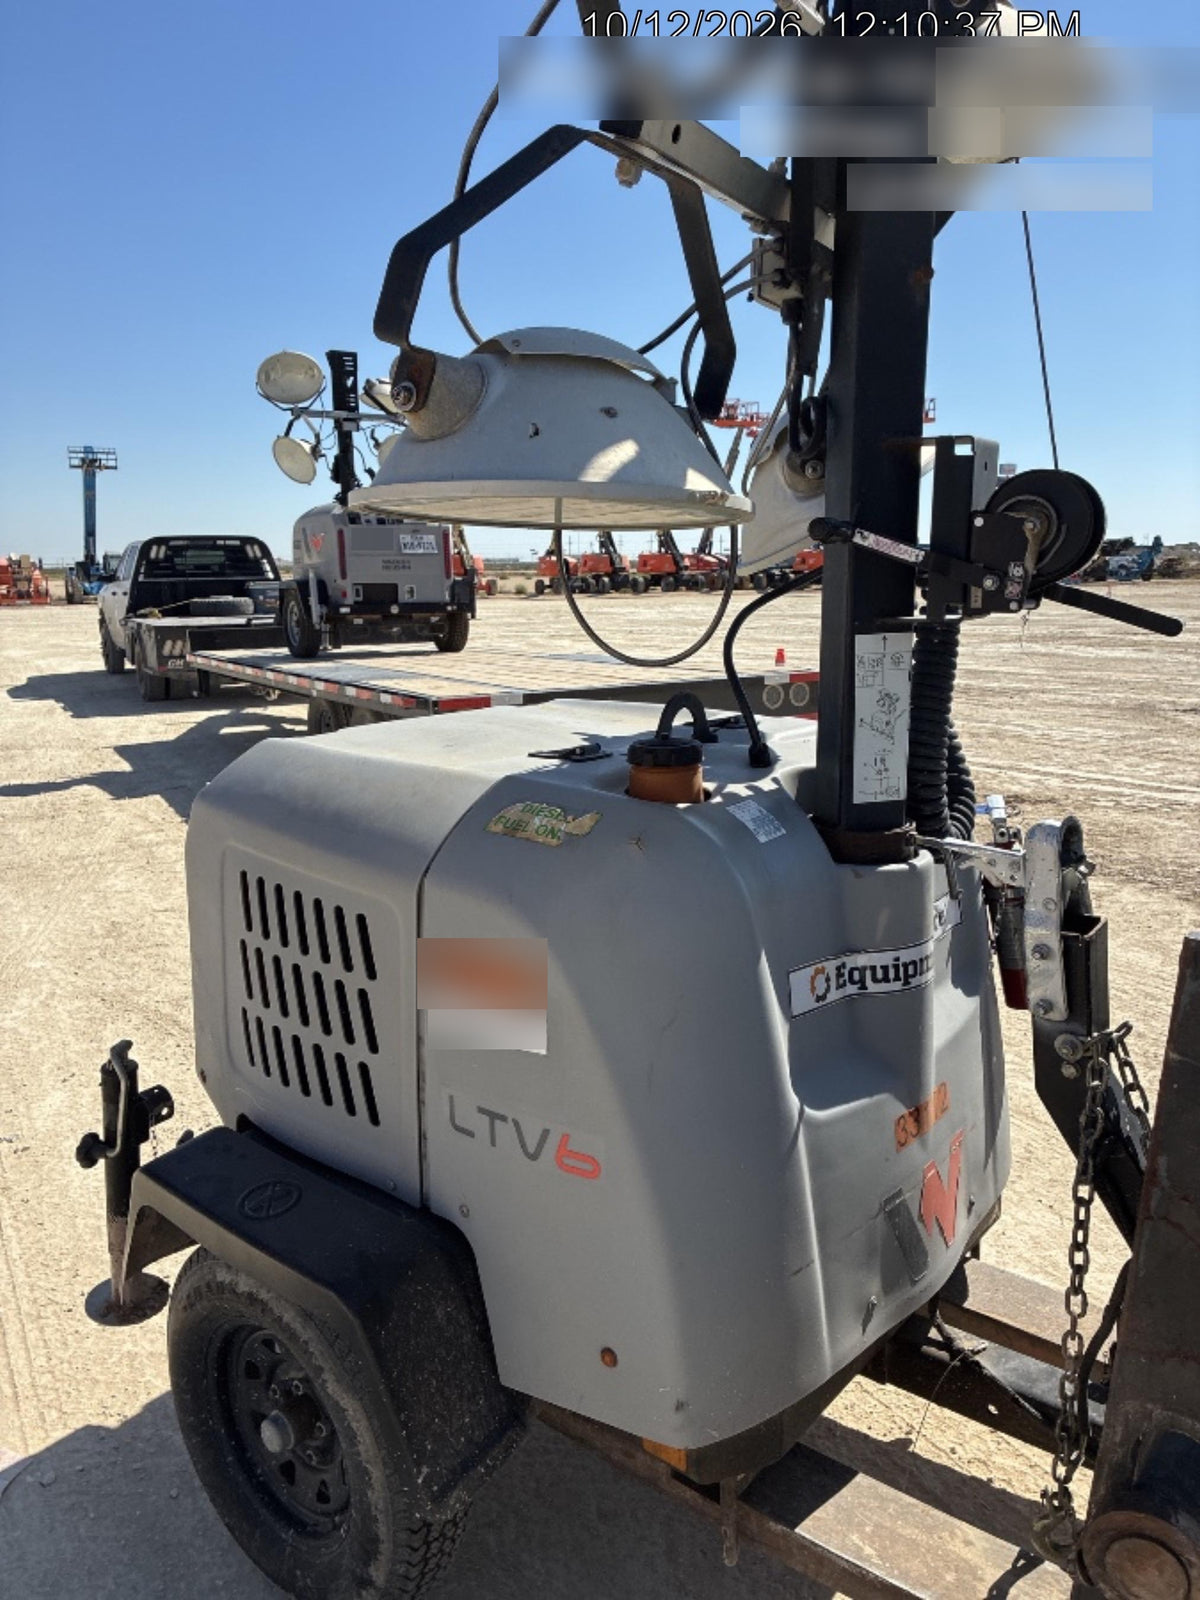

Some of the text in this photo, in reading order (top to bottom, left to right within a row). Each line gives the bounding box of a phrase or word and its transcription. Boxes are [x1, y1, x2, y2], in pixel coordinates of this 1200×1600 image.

[494, 815, 562, 840] FUEL ON
[448, 1094, 602, 1180] LTV6
